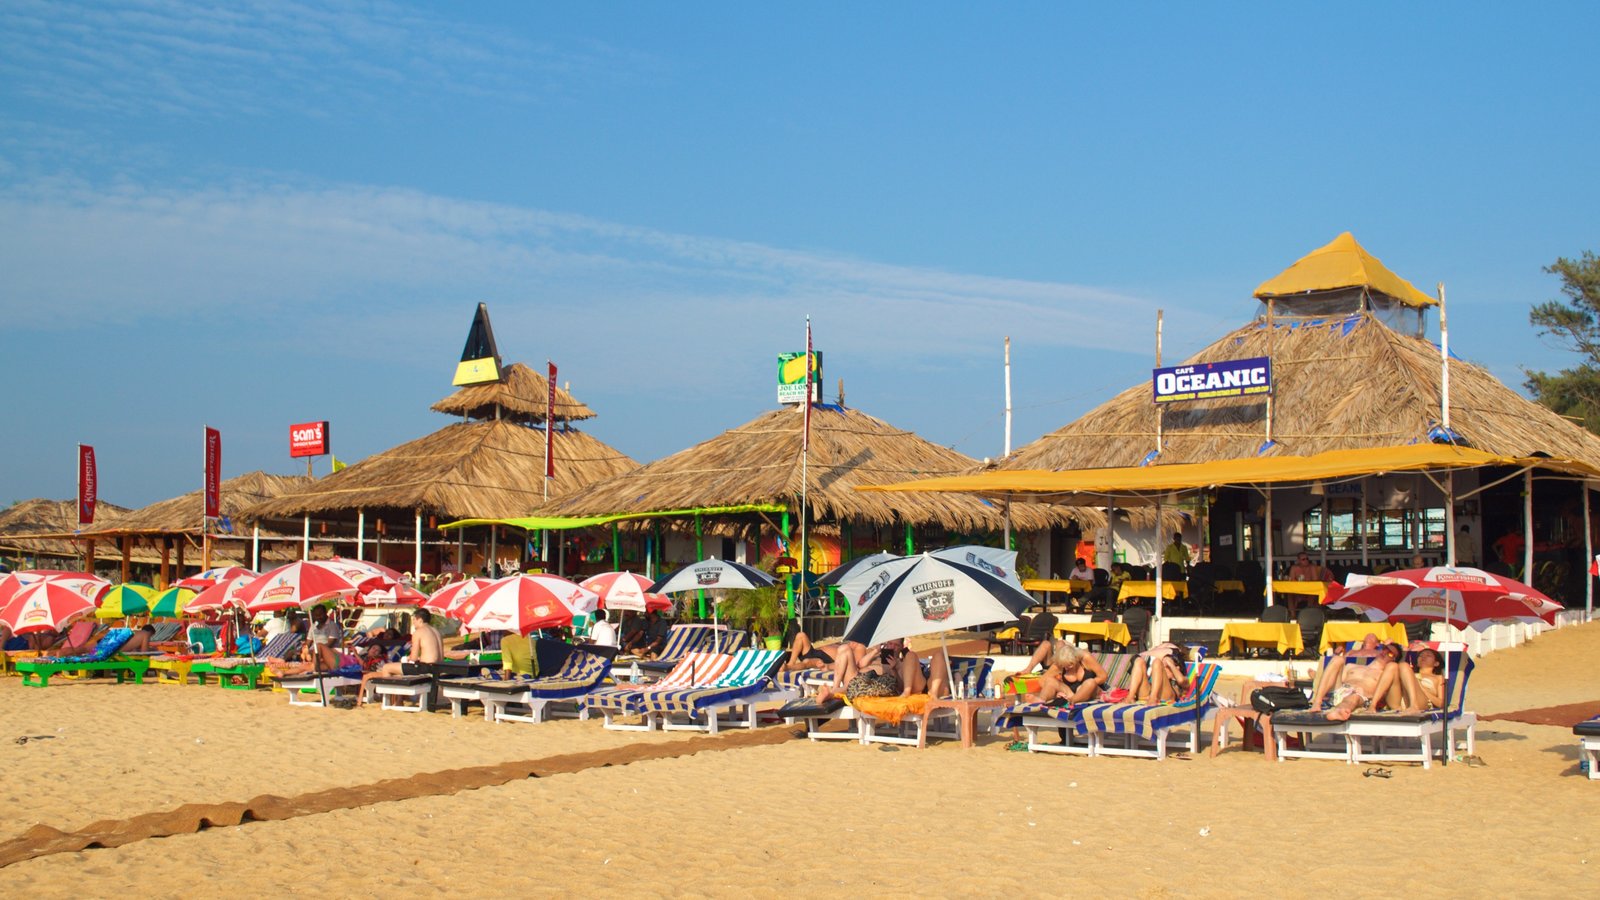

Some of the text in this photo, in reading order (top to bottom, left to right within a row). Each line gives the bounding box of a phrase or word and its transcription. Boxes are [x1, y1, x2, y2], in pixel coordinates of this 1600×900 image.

[1157, 367, 1266, 395] OCEANIC
[1437, 575, 1483, 584] KINGFISHER
[913, 580, 953, 594] SMIRNOFF
[924, 595, 949, 609] ICE
